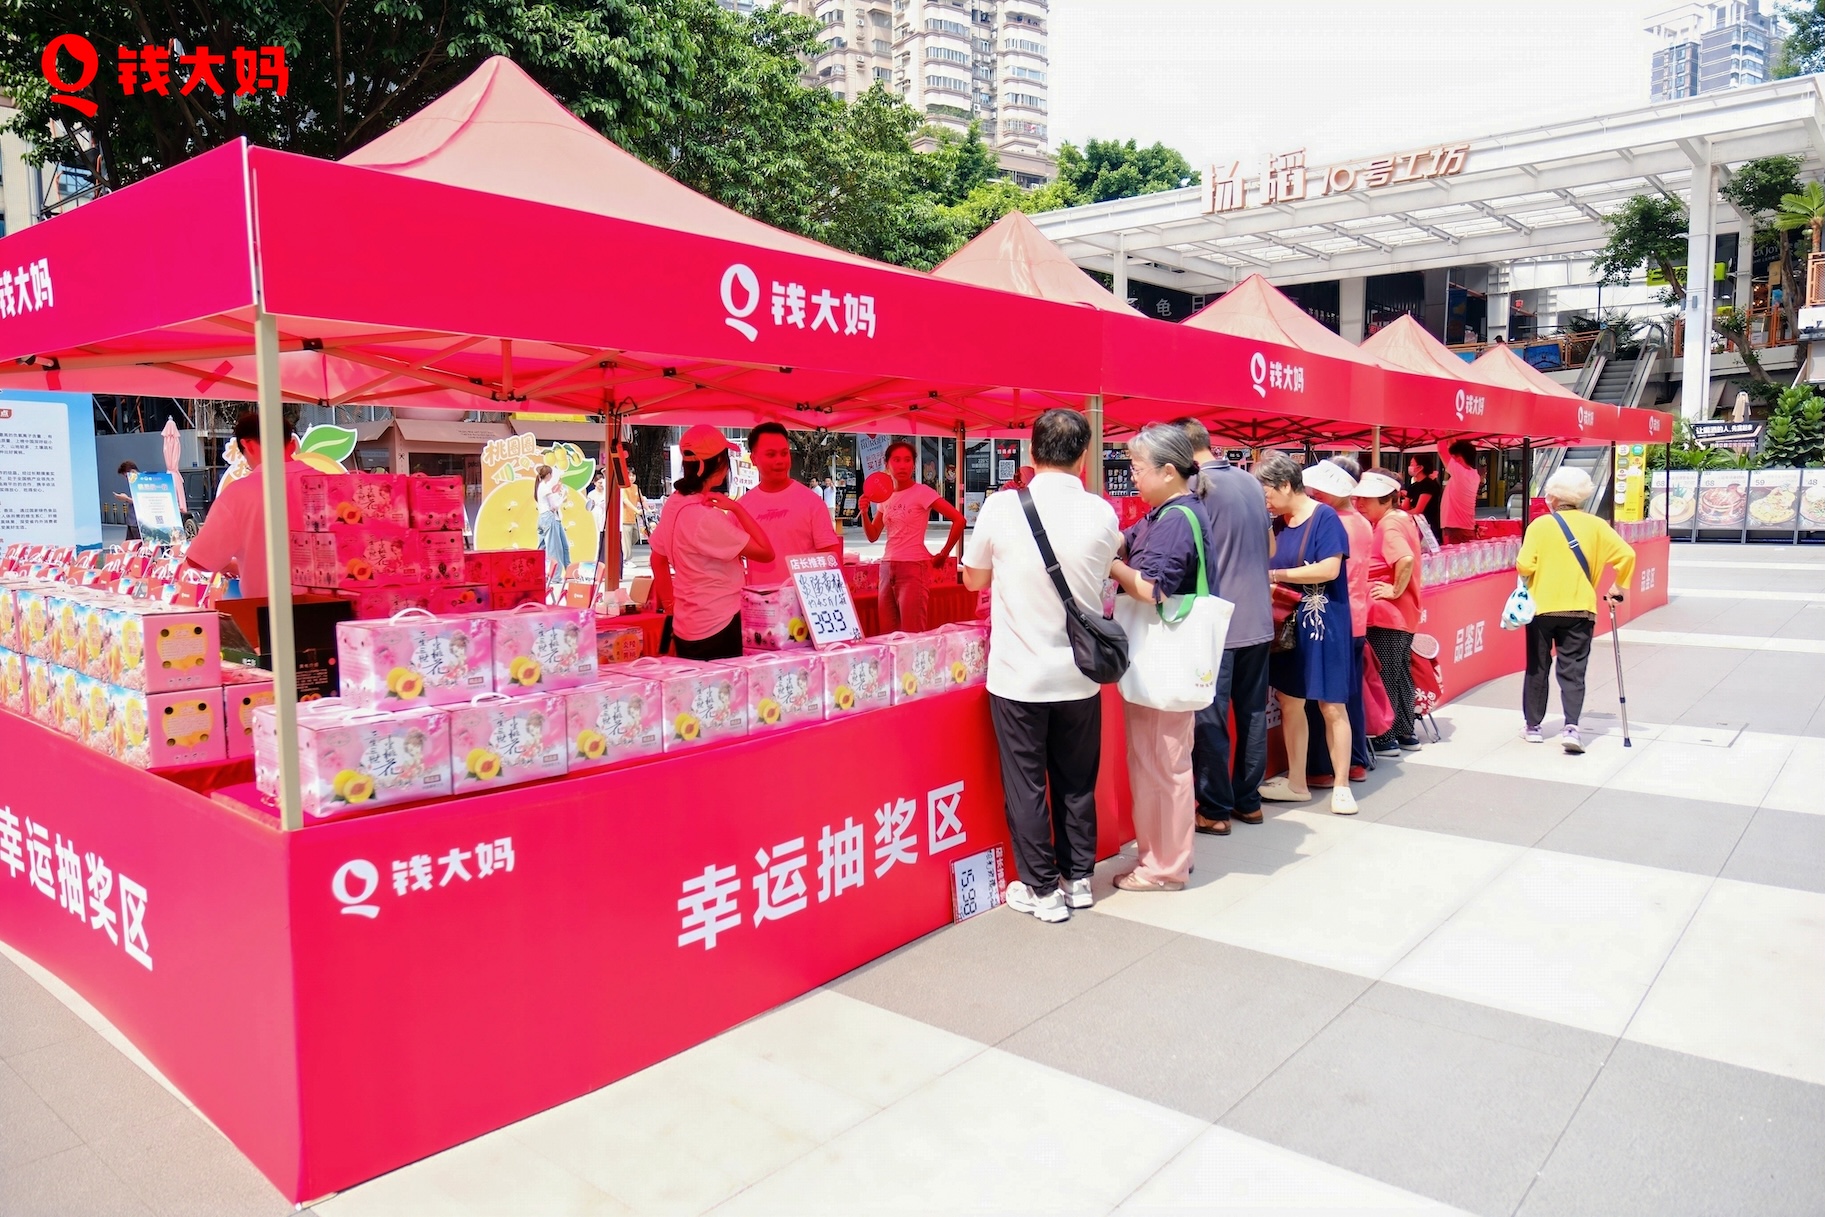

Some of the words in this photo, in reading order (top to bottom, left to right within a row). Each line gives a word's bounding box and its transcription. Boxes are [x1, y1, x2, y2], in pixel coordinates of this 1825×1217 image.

[771, 280, 876, 339] 钱大妈
[1269, 361, 1305, 394] 钱大妈
[1465, 393, 1485, 416] 钱大妈
[484, 434, 535, 465] 桃圈圈
[790, 556, 827, 570] 店长推荐
[811, 609, 847, 635] 39.9
[1454, 620, 1485, 664] 品鉴区
[392, 836, 515, 896] 钱大妈
[678, 781, 967, 951] 幸运抽奖区
[0, 807, 153, 971] 幸运抽奖区
